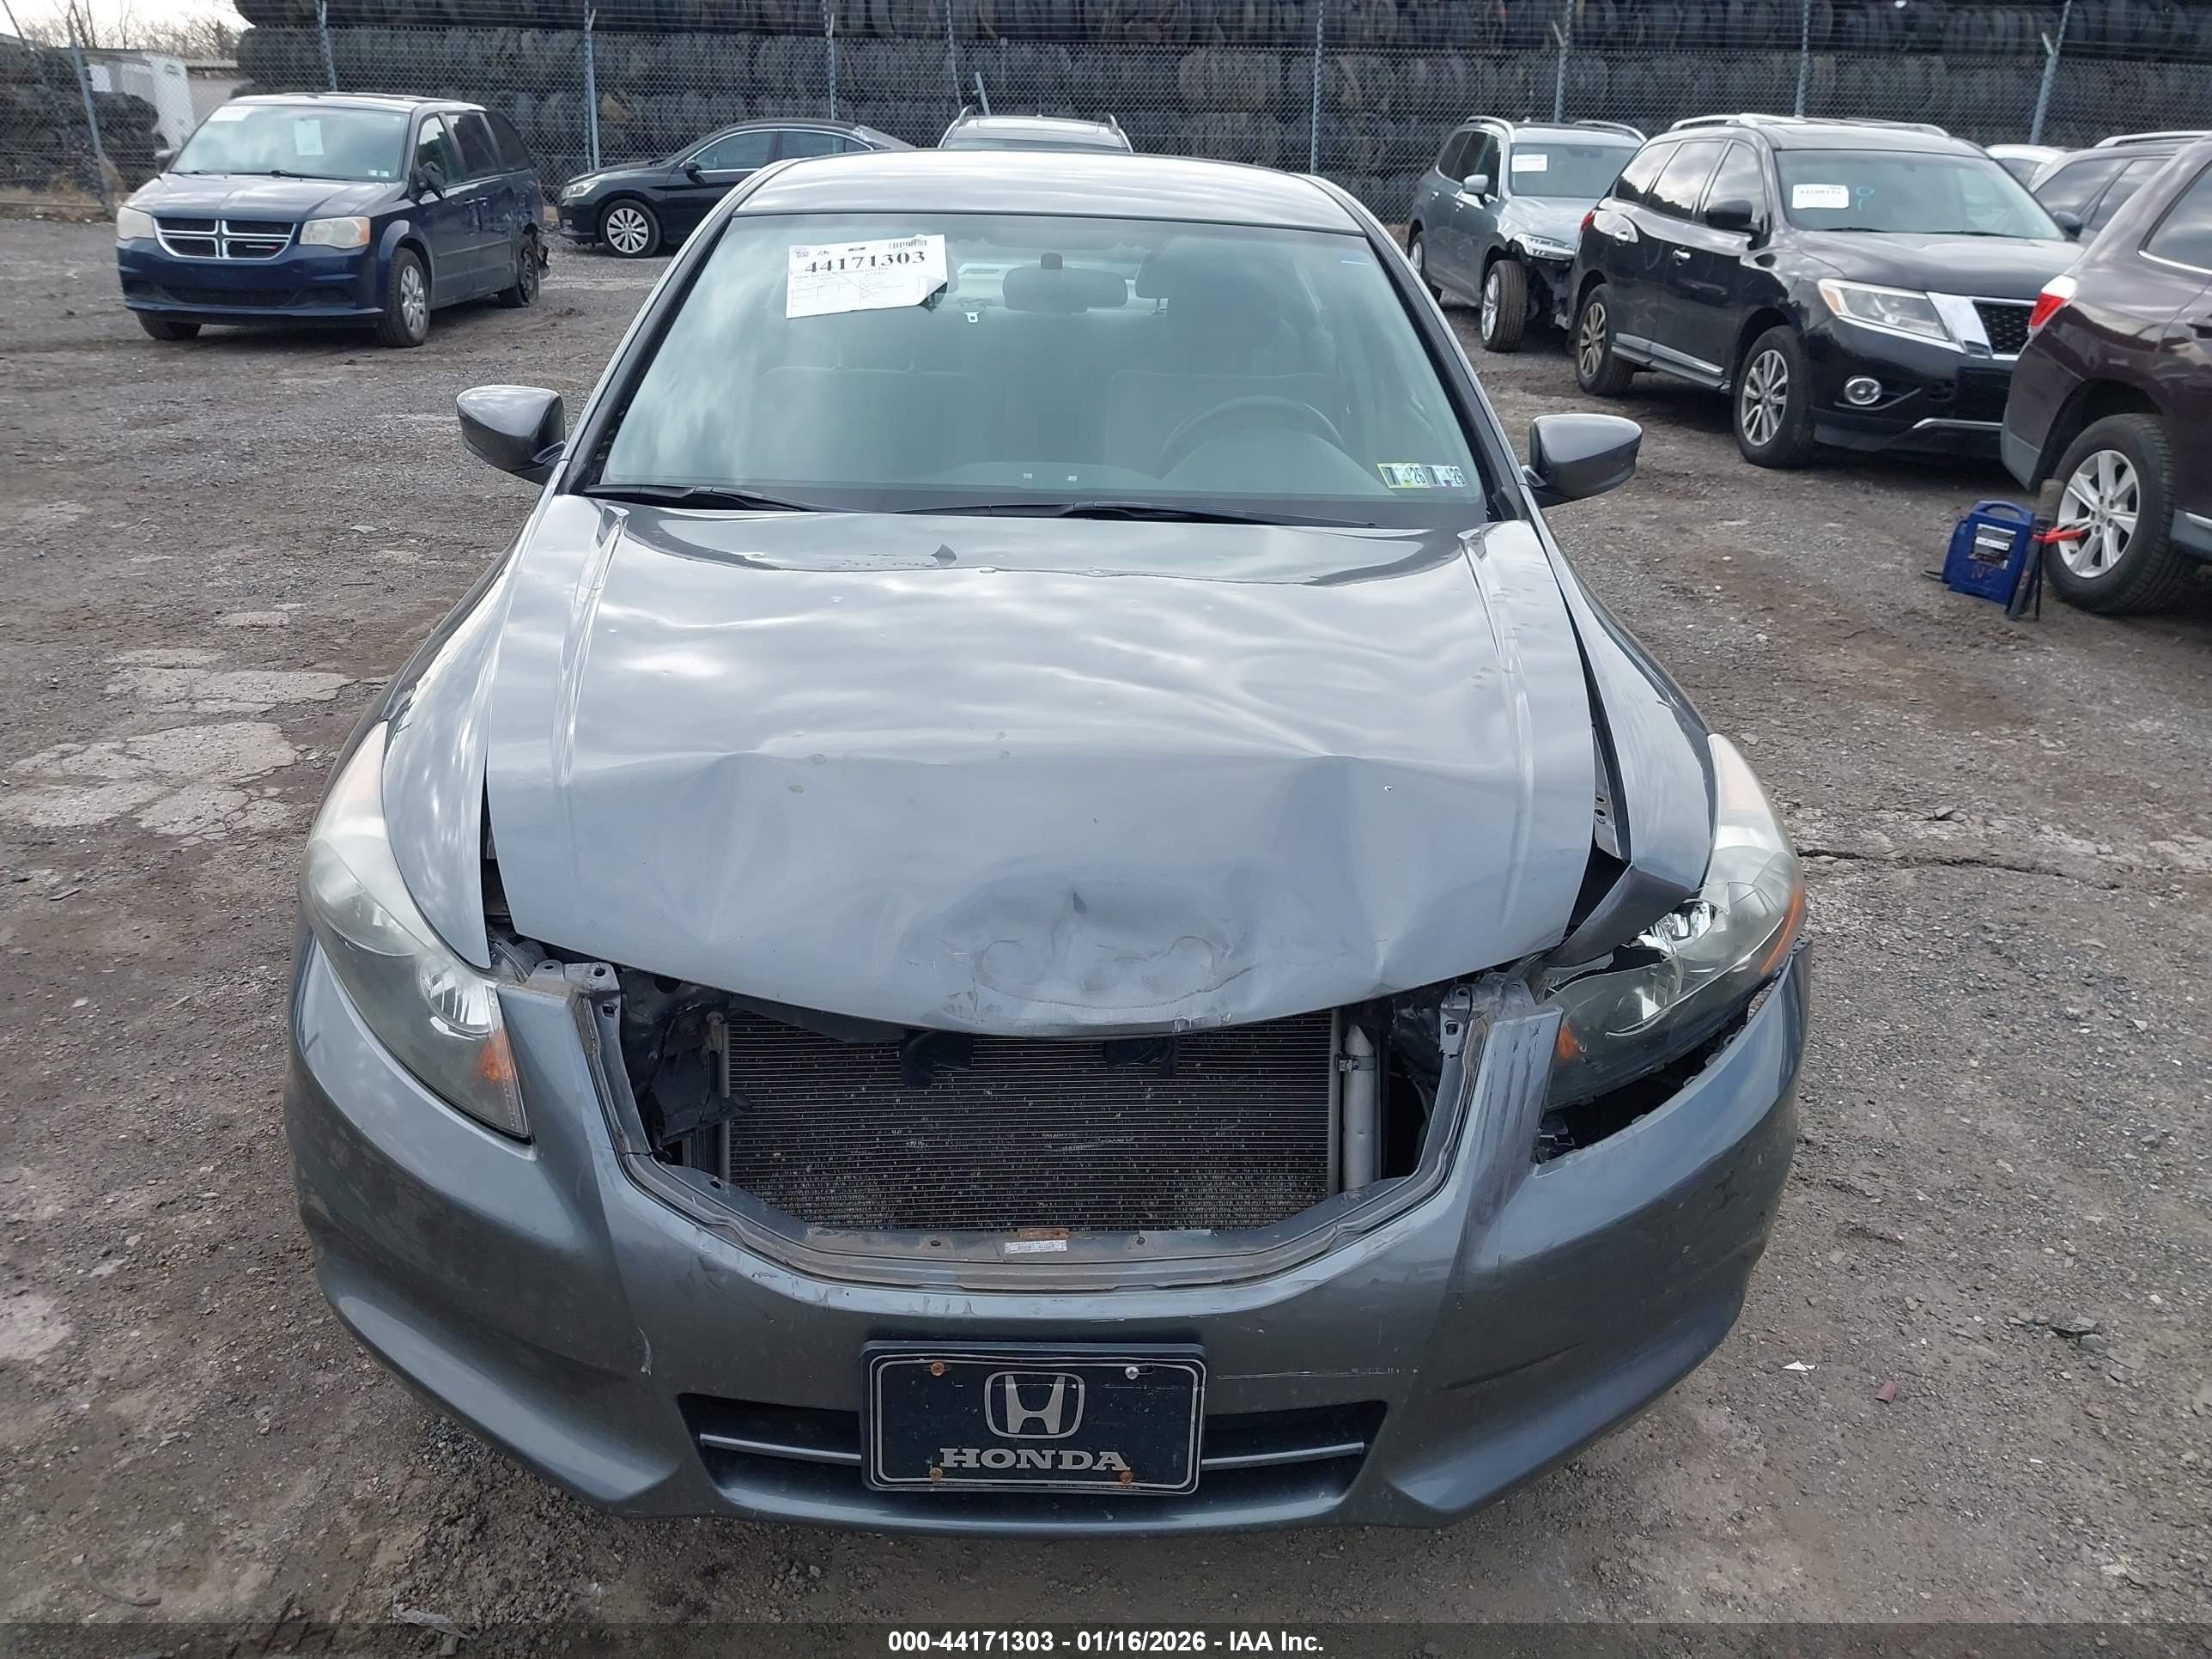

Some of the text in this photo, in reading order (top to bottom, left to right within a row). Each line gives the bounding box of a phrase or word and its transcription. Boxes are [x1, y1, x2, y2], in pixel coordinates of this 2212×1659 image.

[805, 251, 925, 273] 44171303
[1409, 466, 1426, 484] 26
[939, 1447, 1131, 1471] HONDA
